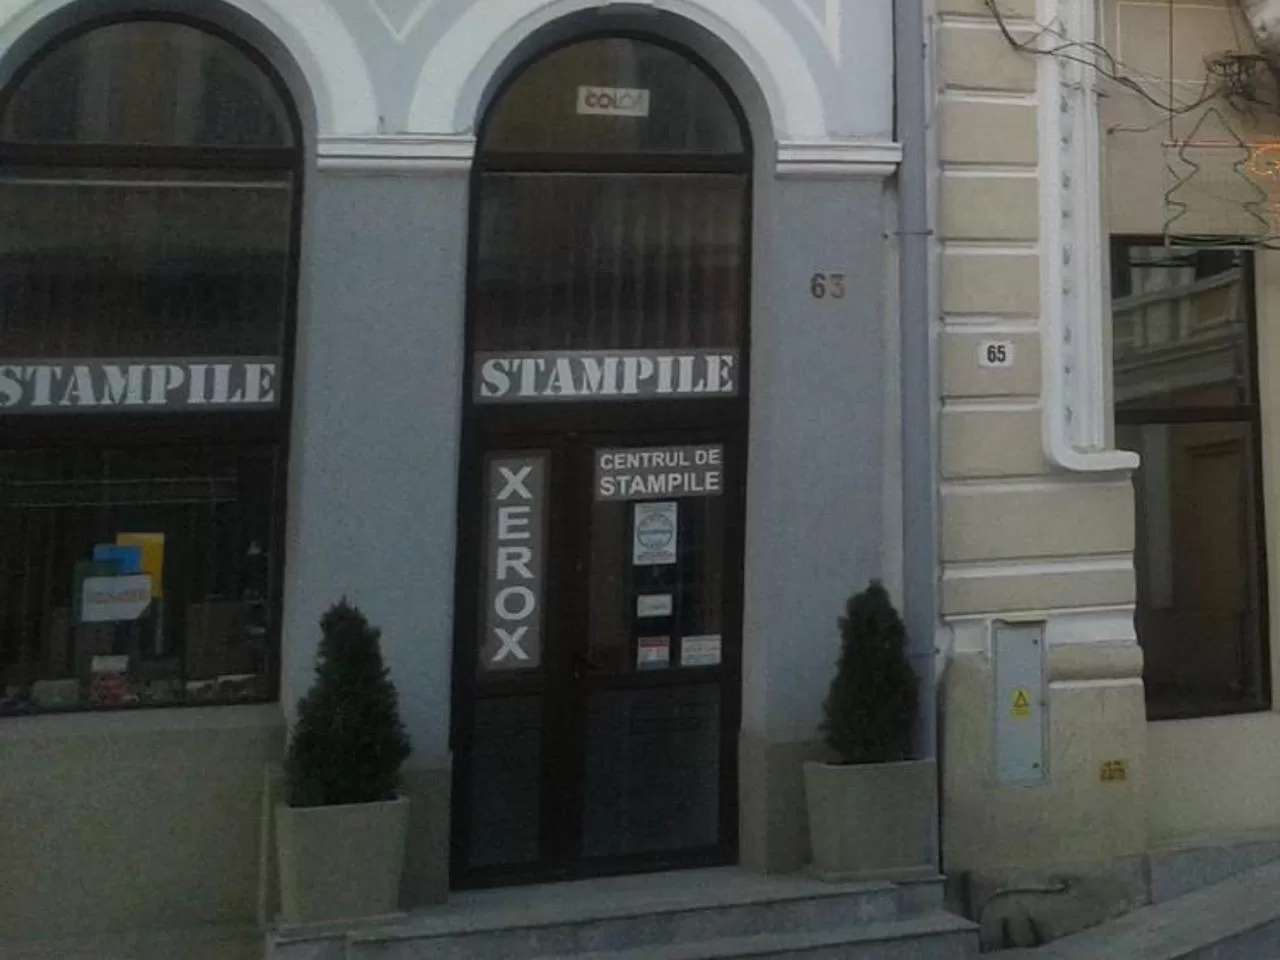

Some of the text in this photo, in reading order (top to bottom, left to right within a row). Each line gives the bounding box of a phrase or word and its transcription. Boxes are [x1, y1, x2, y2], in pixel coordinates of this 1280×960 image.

[811, 273, 845, 299] 63
[987, 345, 1006, 363] 65
[0, 363, 275, 406] STAMPILE
[481, 355, 733, 397] STAMPILE
[600, 449, 721, 470] CENTRUL DE
[600, 471, 720, 496] STAMPILE
[492, 466, 535, 662] XEROX
